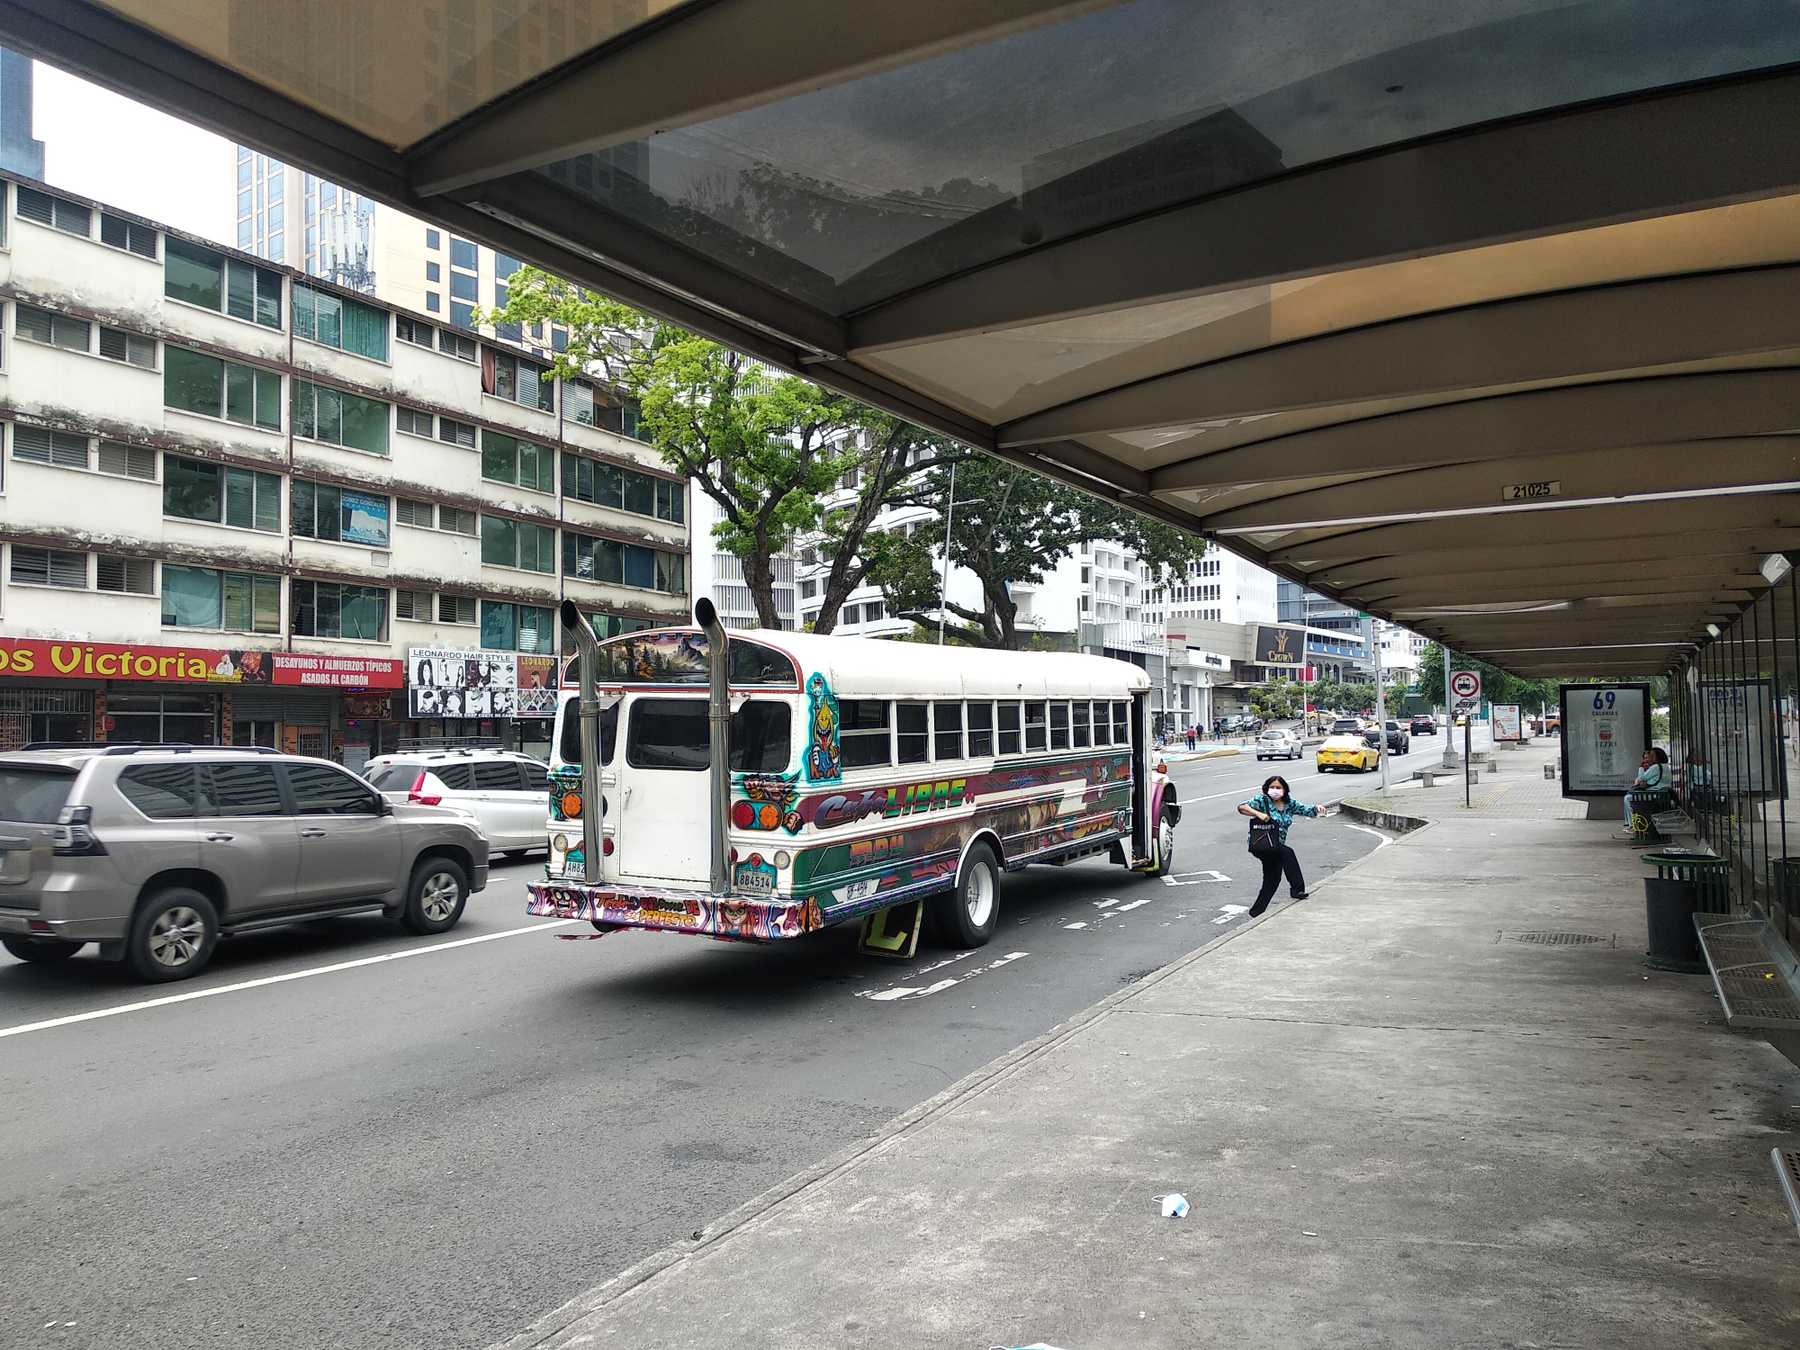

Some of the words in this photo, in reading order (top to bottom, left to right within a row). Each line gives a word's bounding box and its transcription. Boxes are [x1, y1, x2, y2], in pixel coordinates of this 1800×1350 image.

[1513, 482, 1551, 498] 21025
[414, 649, 462, 659] LEONARDO
[521, 656, 555, 667] LEONARDO
[51, 645, 208, 680] Victoria
[275, 656, 318, 669] DESAYUNOS
[319, 659, 325, 670] Y
[325, 659, 365, 672] ALMUERZOS
[365, 660, 392, 673] TÍPICOS
[301, 673, 331, 684] ASADOS
[331, 674, 340, 684] AL
[340, 673, 369, 686] CARBÓN
[1593, 691, 1616, 710] 69
[813, 790, 887, 829] Cuba
[882, 779, 967, 819] LIBRE
[567, 862, 585, 874] AH82
[683, 900, 701, 916] DE
